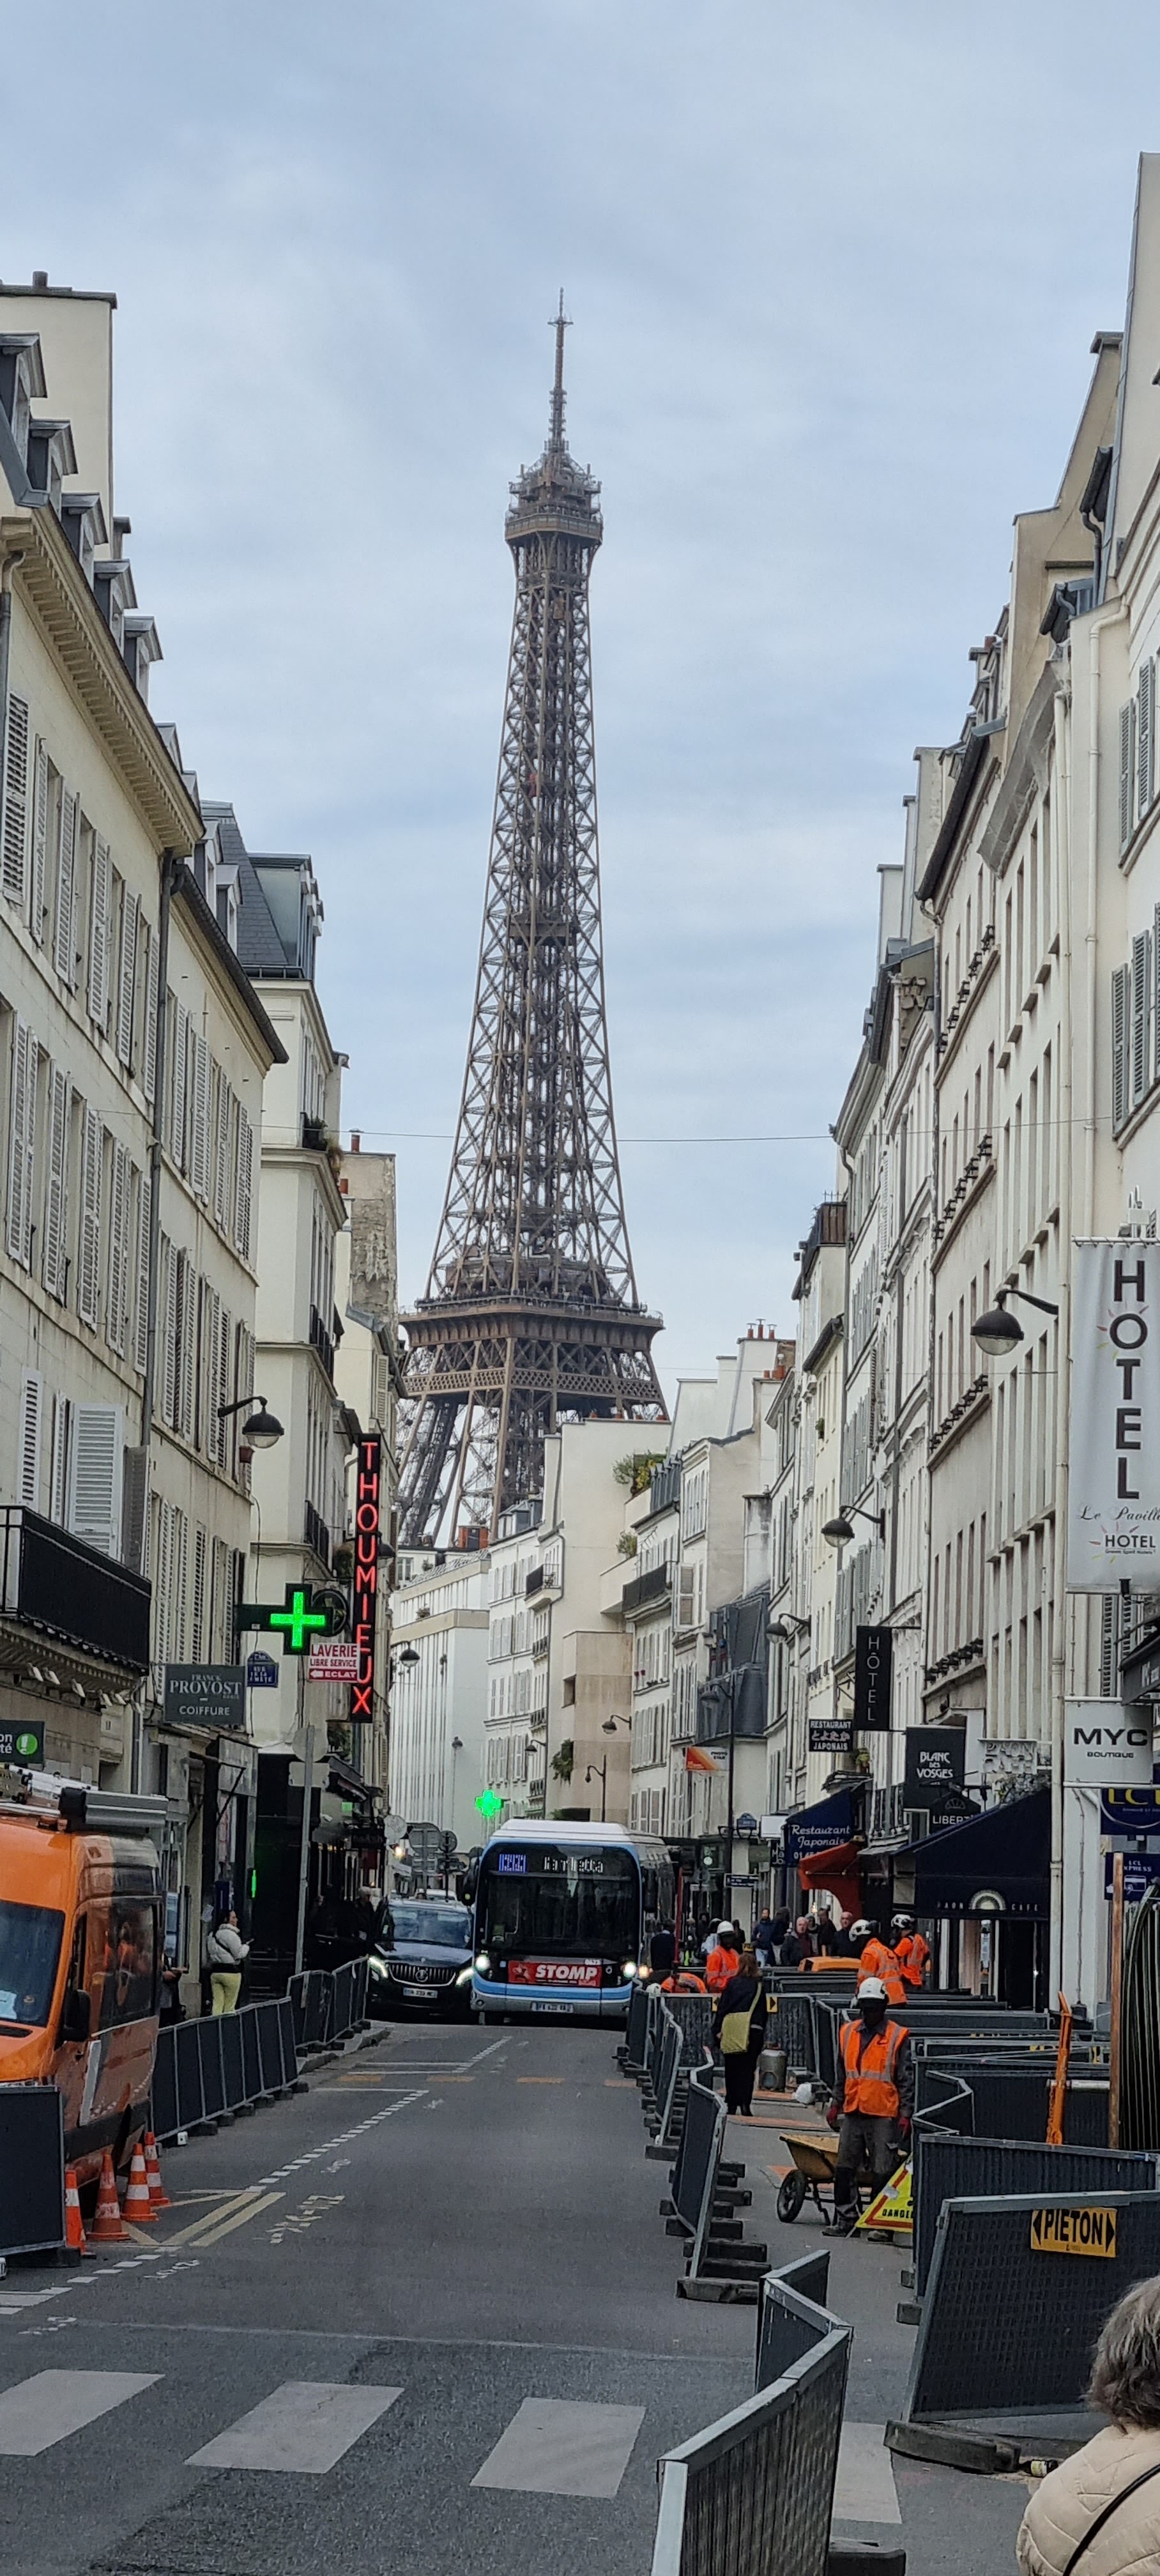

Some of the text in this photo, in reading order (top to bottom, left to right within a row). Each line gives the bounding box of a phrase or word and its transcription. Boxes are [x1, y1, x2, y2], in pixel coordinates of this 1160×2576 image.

[1110, 1259, 1148, 1499] HOTEL
[1079, 1505, 1101, 1521] Le
[1105, 1535, 1156, 1548] HOTEL
[352, 1441, 378, 1714] THOUMIEUX
[311, 1644, 357, 1658] LAVERIE
[330, 1659, 356, 1667] SERVICE
[867, 1636, 880, 1721] HÔTEL
[170, 1680, 242, 1695] PROVOST
[179, 1705, 230, 1716] COIFFURE
[810, 1721, 851, 1729] RESTAURANT
[1074, 1728, 1148, 1746] MYC
[813, 1742, 848, 1751] JAPONAIS
[920, 1751, 950, 1763] BLANC
[917, 1768, 953, 1779] VOSGES
[791, 1825, 851, 1835] Restaurant
[798, 1836, 845, 1848] Japonais
[535, 1965, 598, 1979] STOMP
[1044, 2209, 1103, 2245] PIETON
